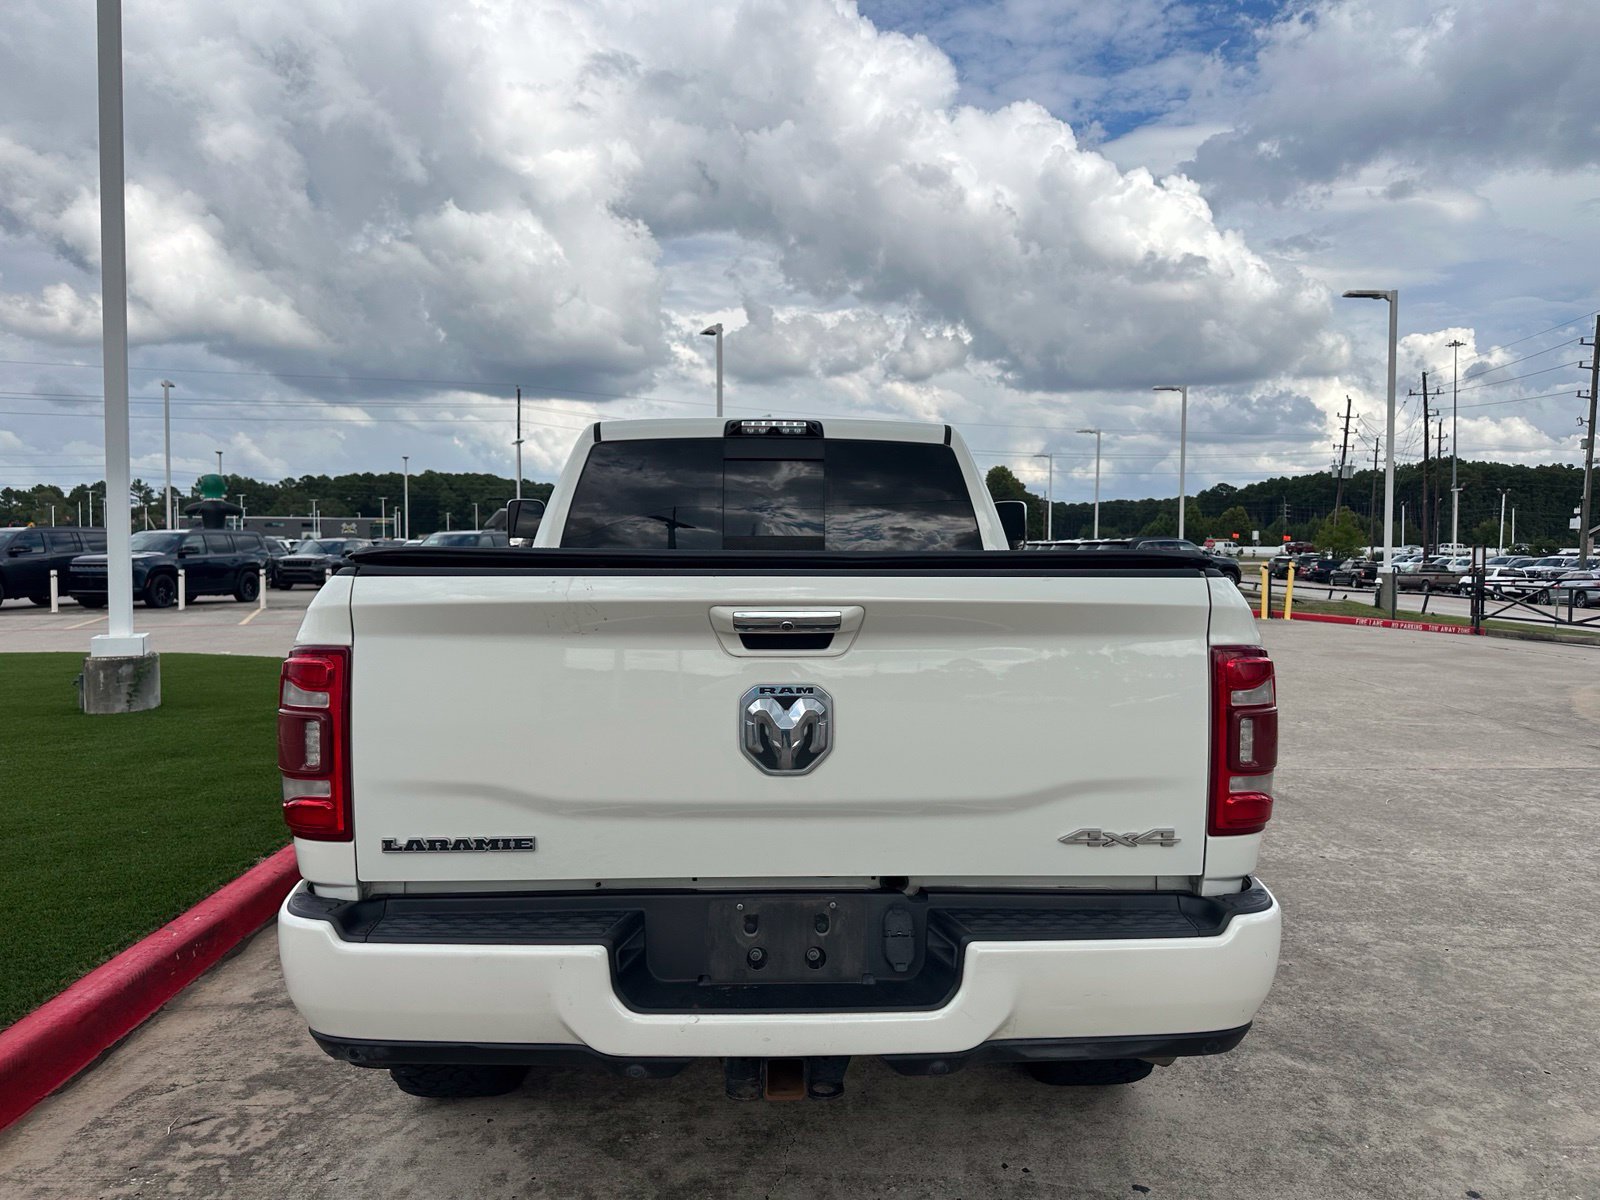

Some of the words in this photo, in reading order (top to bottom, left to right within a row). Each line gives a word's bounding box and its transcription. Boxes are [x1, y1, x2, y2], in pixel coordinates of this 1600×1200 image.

[1400, 623, 1423, 631] PARKING
[759, 687, 814, 695] RAM
[382, 836, 535, 853] LARAMIE
